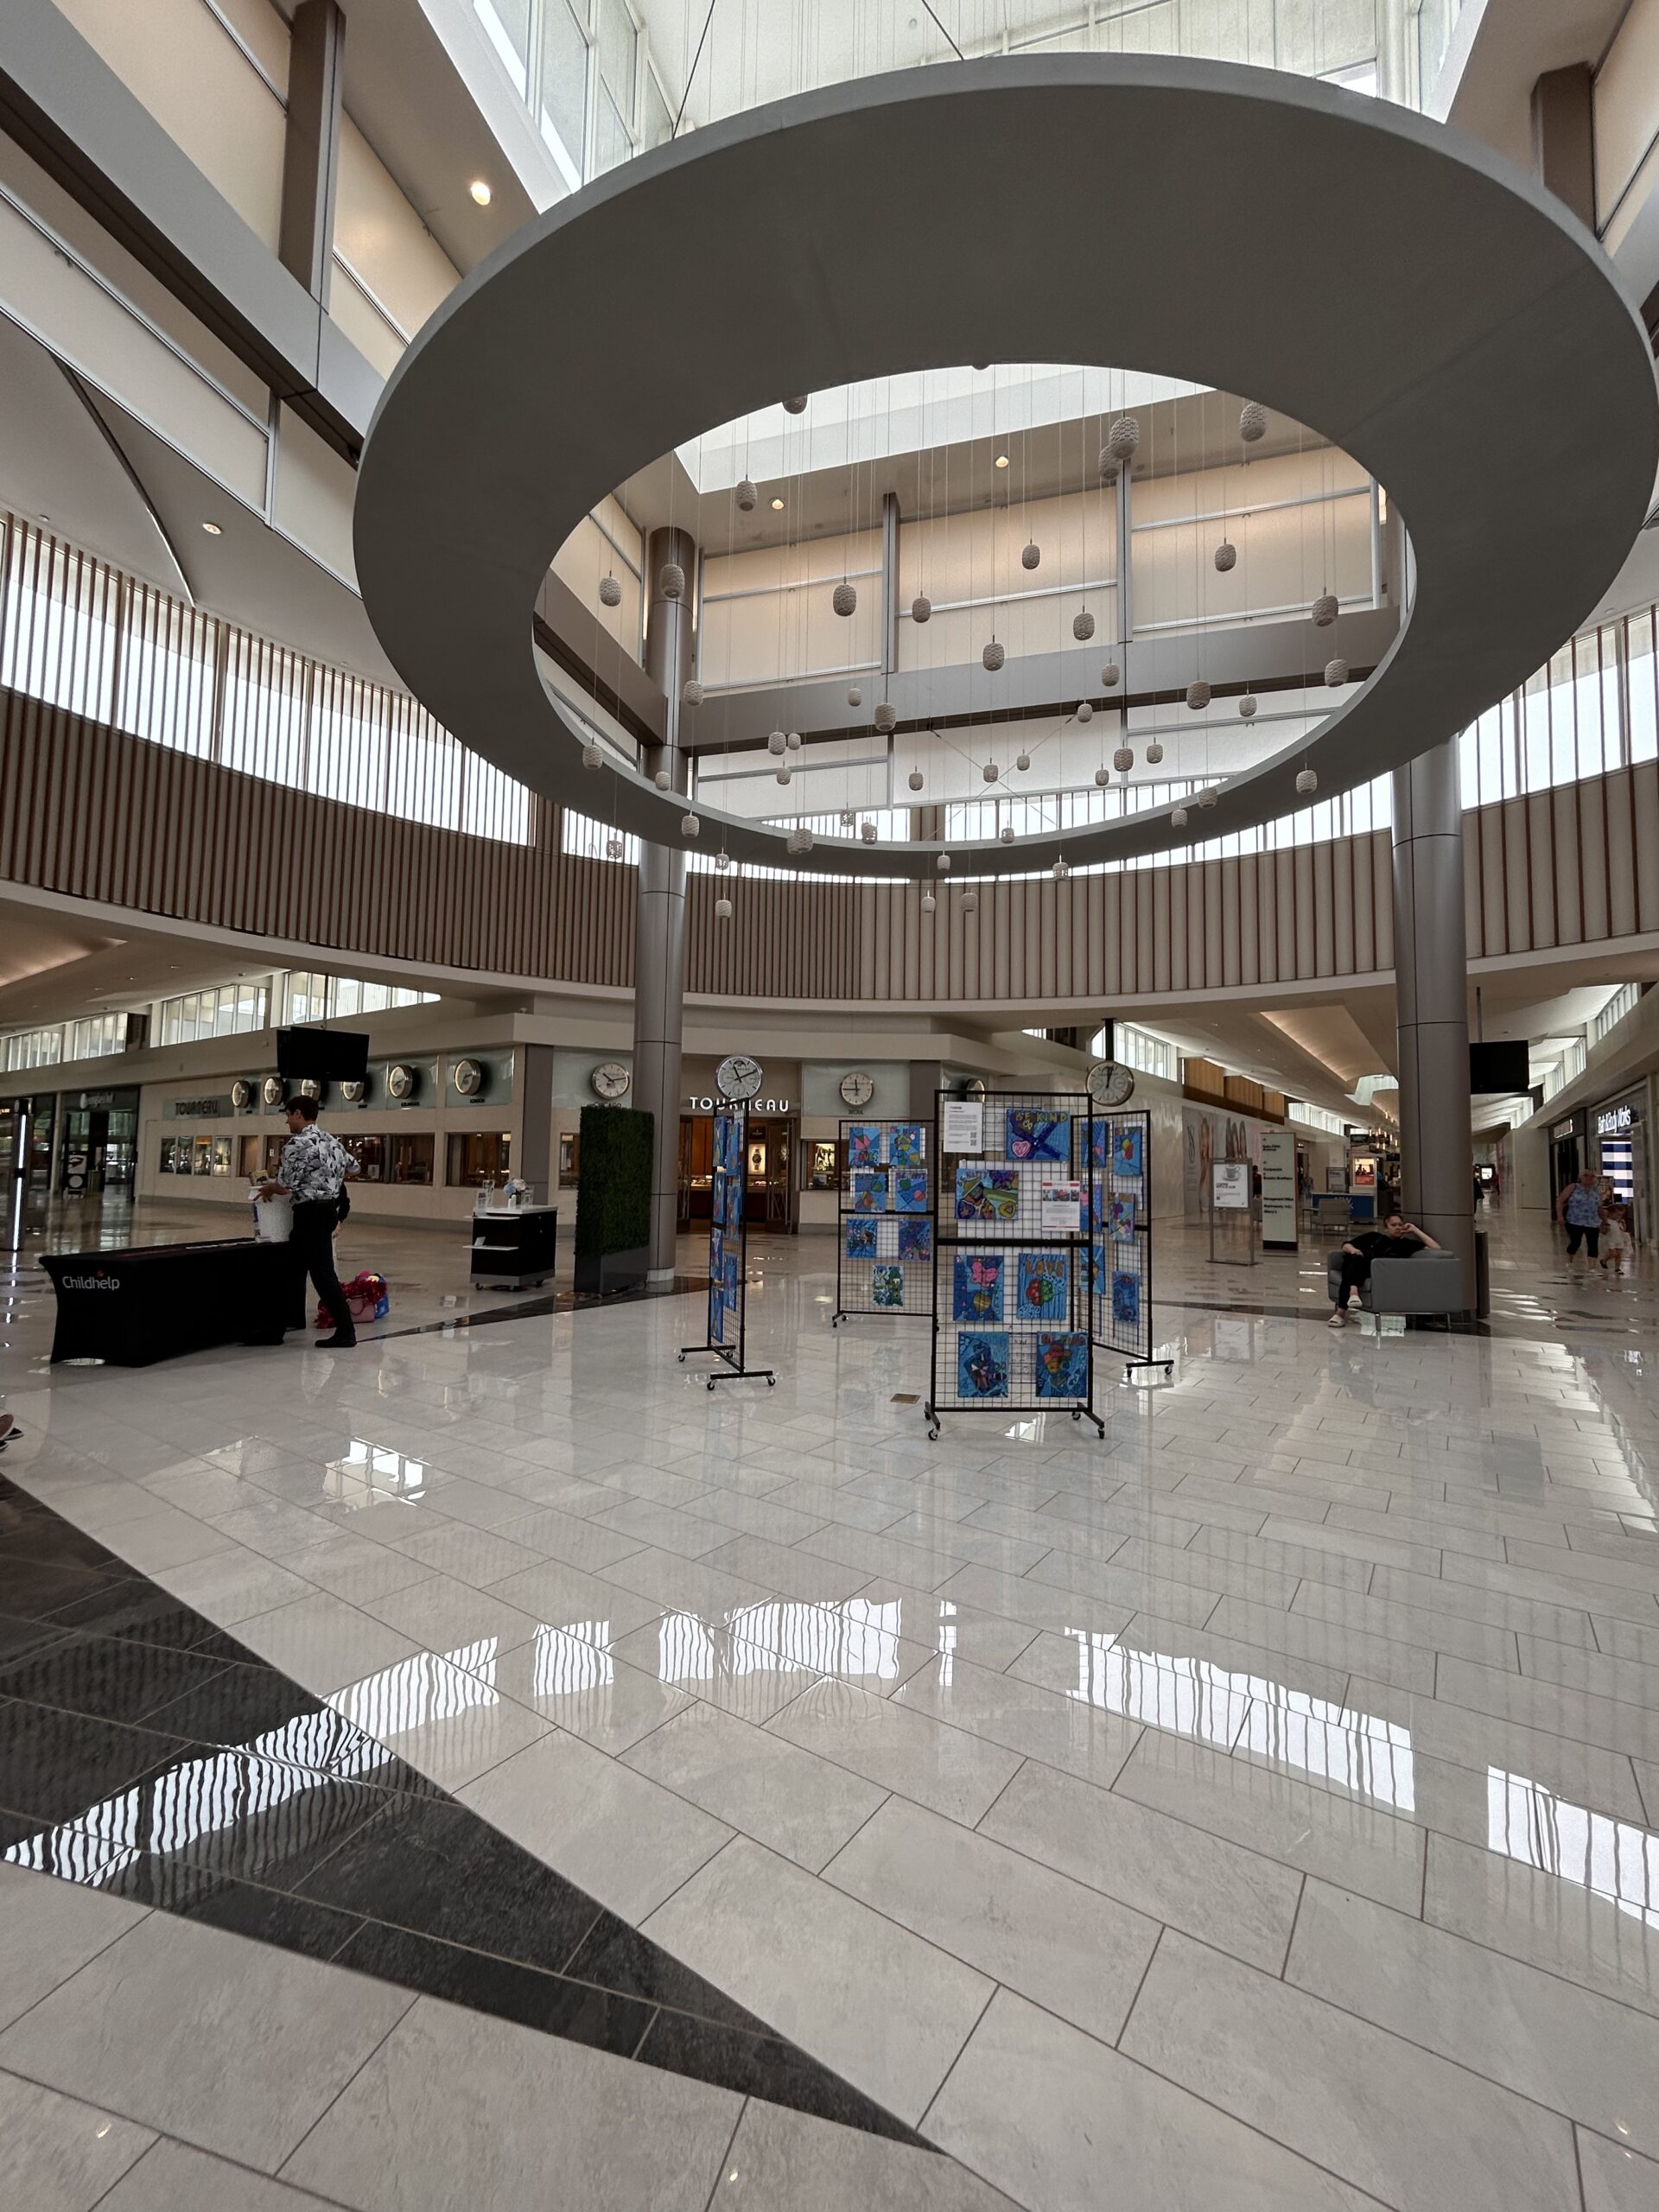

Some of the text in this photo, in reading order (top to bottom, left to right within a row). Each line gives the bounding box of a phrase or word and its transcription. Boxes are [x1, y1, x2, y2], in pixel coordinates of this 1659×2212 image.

[1015, 1111, 1068, 1123] BE KIND
[1025, 1258, 1065, 1278] LOVE
[62, 1275, 120, 1291] Childhelp
